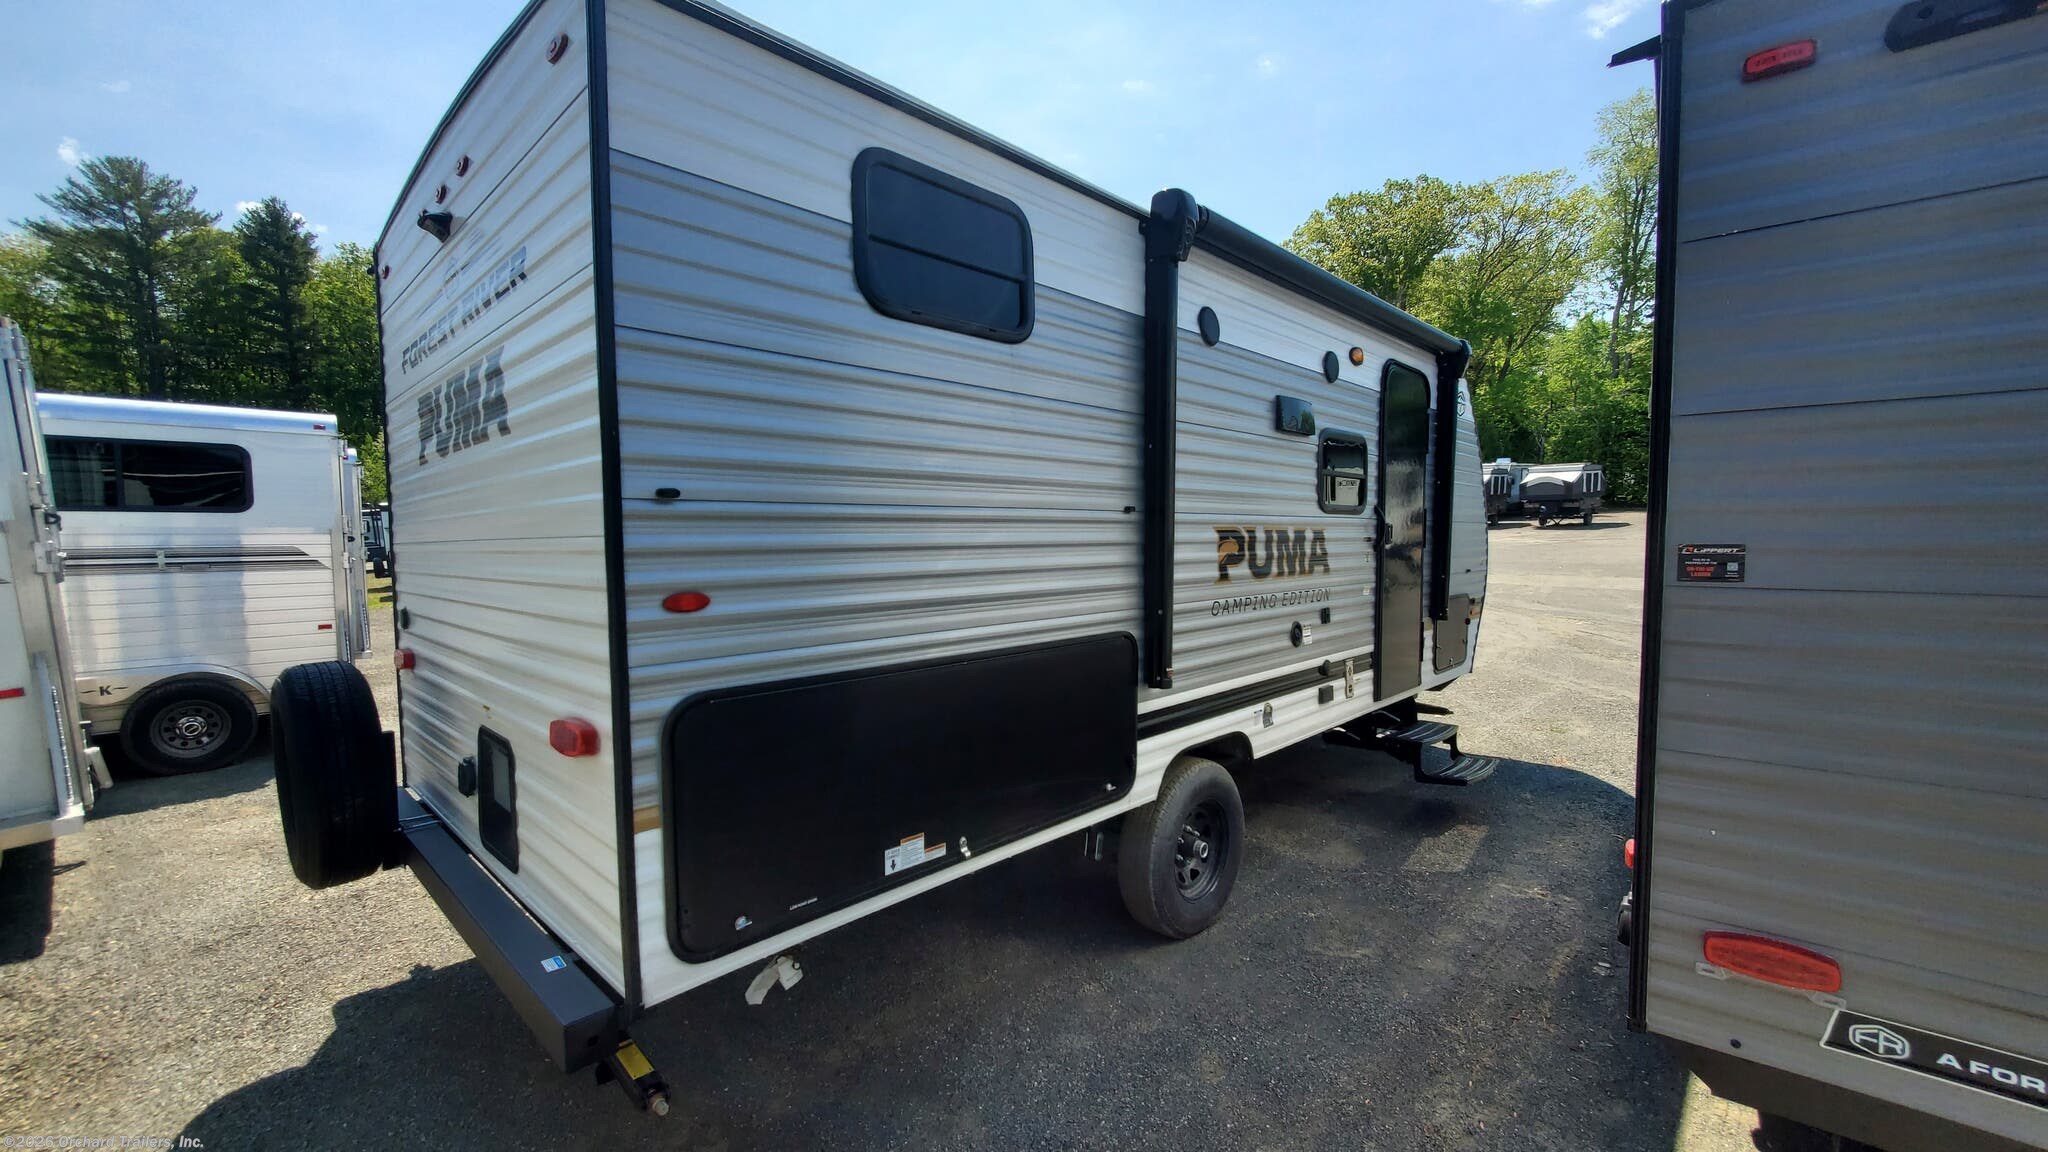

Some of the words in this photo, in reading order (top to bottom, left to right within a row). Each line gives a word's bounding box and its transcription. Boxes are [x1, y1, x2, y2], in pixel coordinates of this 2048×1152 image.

[461, 246, 527, 330] RIVER
[417, 345, 511, 466] PUMA
[1212, 526, 1331, 584] PUMA
[1211, 594, 1278, 616] CAMPING
[1281, 588, 1331, 606] EDITION
[1936, 1053, 1963, 1071] A
